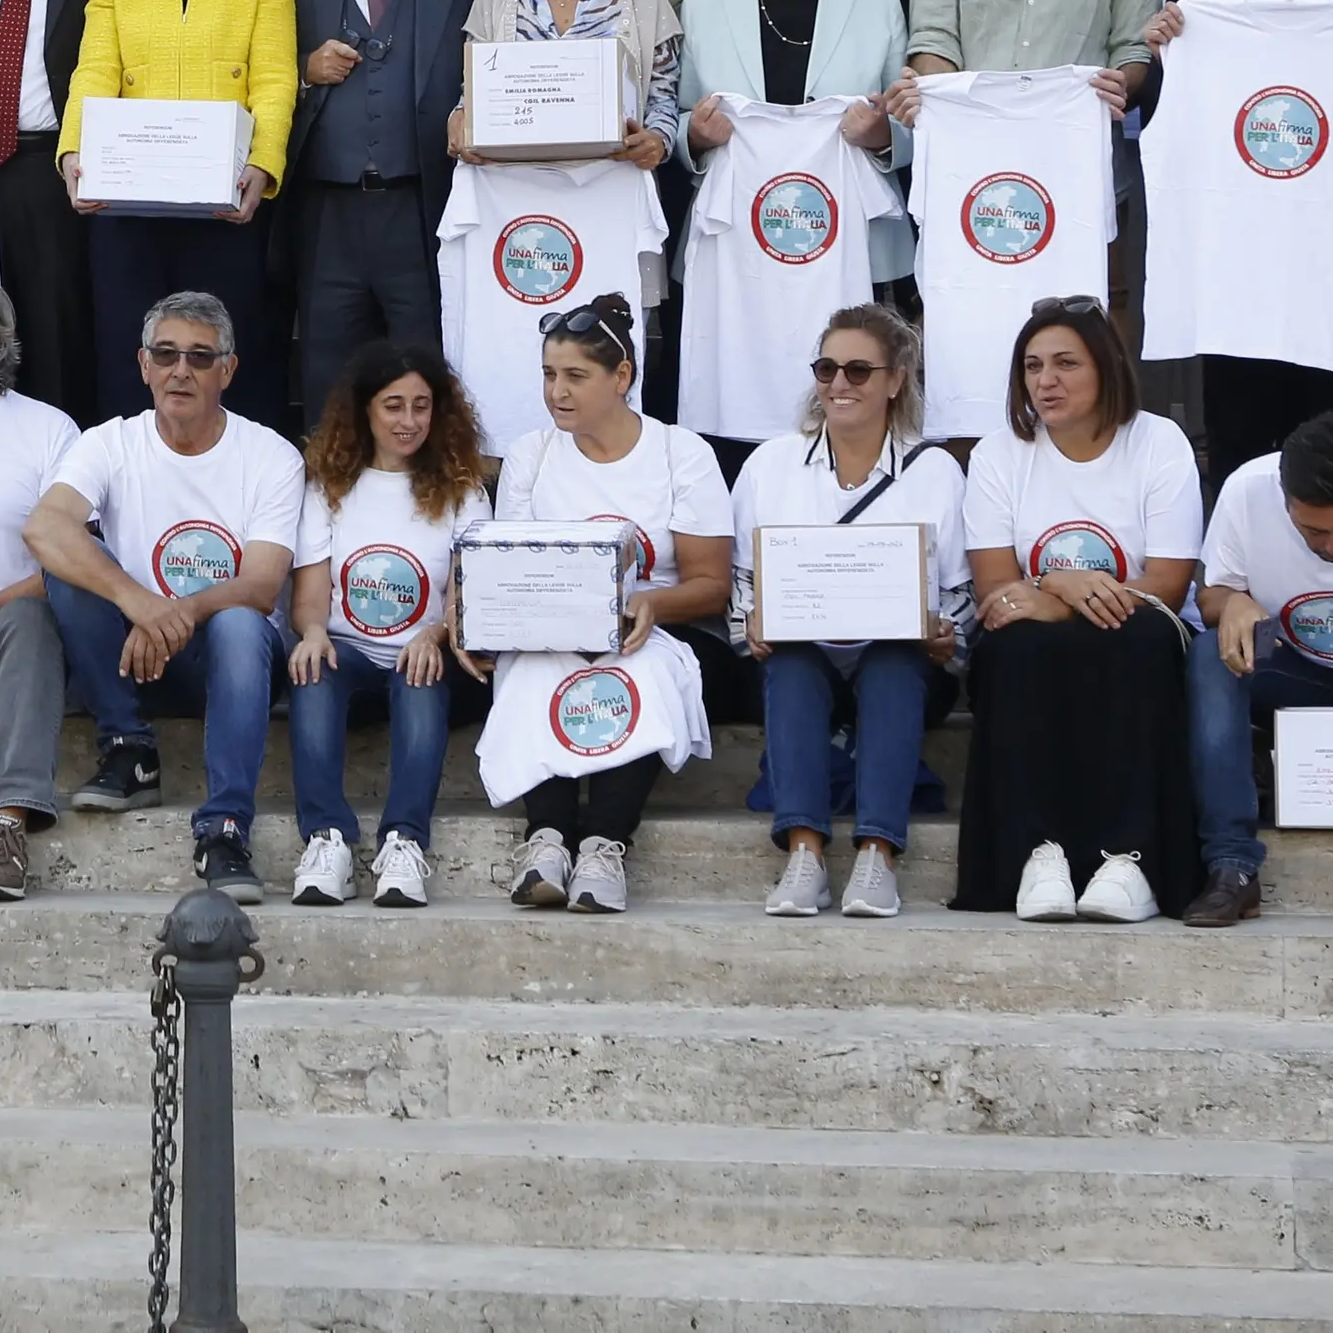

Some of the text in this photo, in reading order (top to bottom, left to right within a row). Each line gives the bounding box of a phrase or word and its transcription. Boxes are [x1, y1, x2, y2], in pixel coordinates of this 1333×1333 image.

[483, 48, 498, 71] 1
[974, 217, 995, 227] PER
[506, 258, 524, 268] PER
[165, 567, 184, 577] PER
[350, 588, 368, 599] PER
[564, 716, 586, 726] PER
